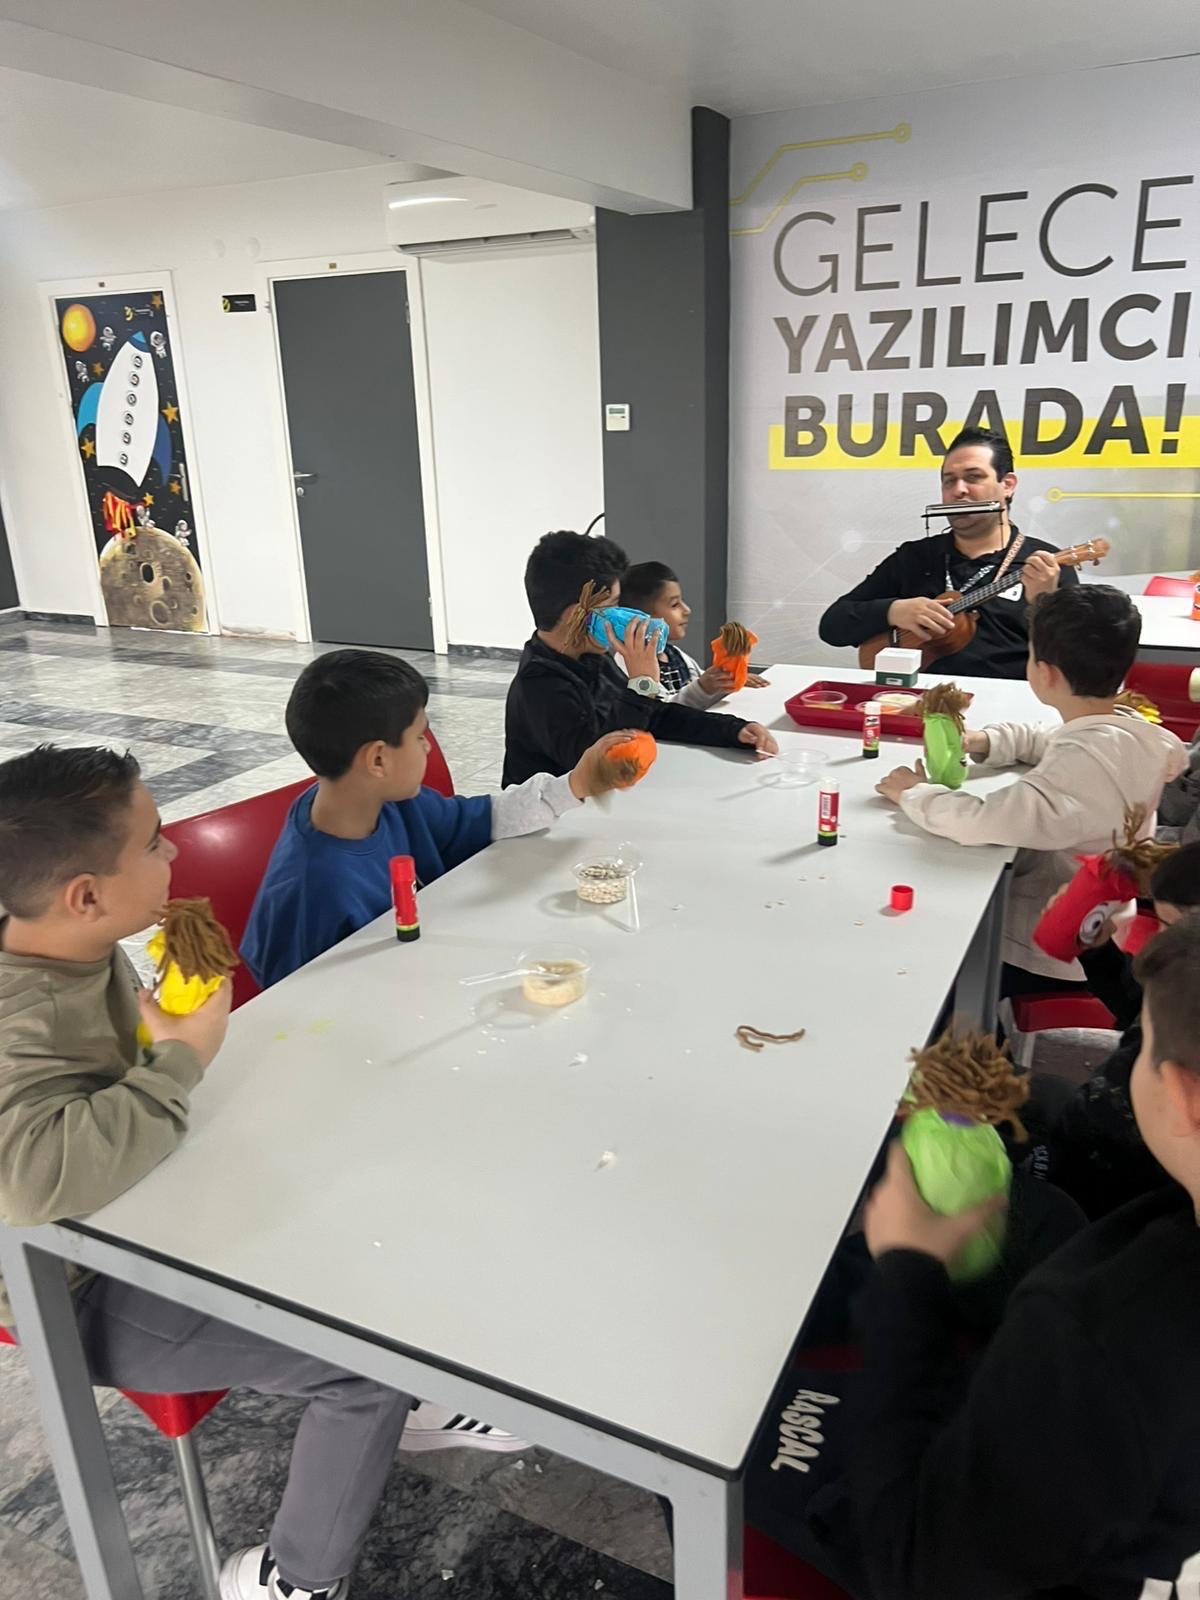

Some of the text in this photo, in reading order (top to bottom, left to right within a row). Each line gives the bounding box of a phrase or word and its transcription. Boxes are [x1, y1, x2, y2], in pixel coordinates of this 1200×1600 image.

[773, 175, 1195, 296] GELECE
[774, 291, 1200, 374] YAZILIMCI
[783, 382, 1187, 458] BURADA!
[770, 1389, 841, 1473] RASCAL
